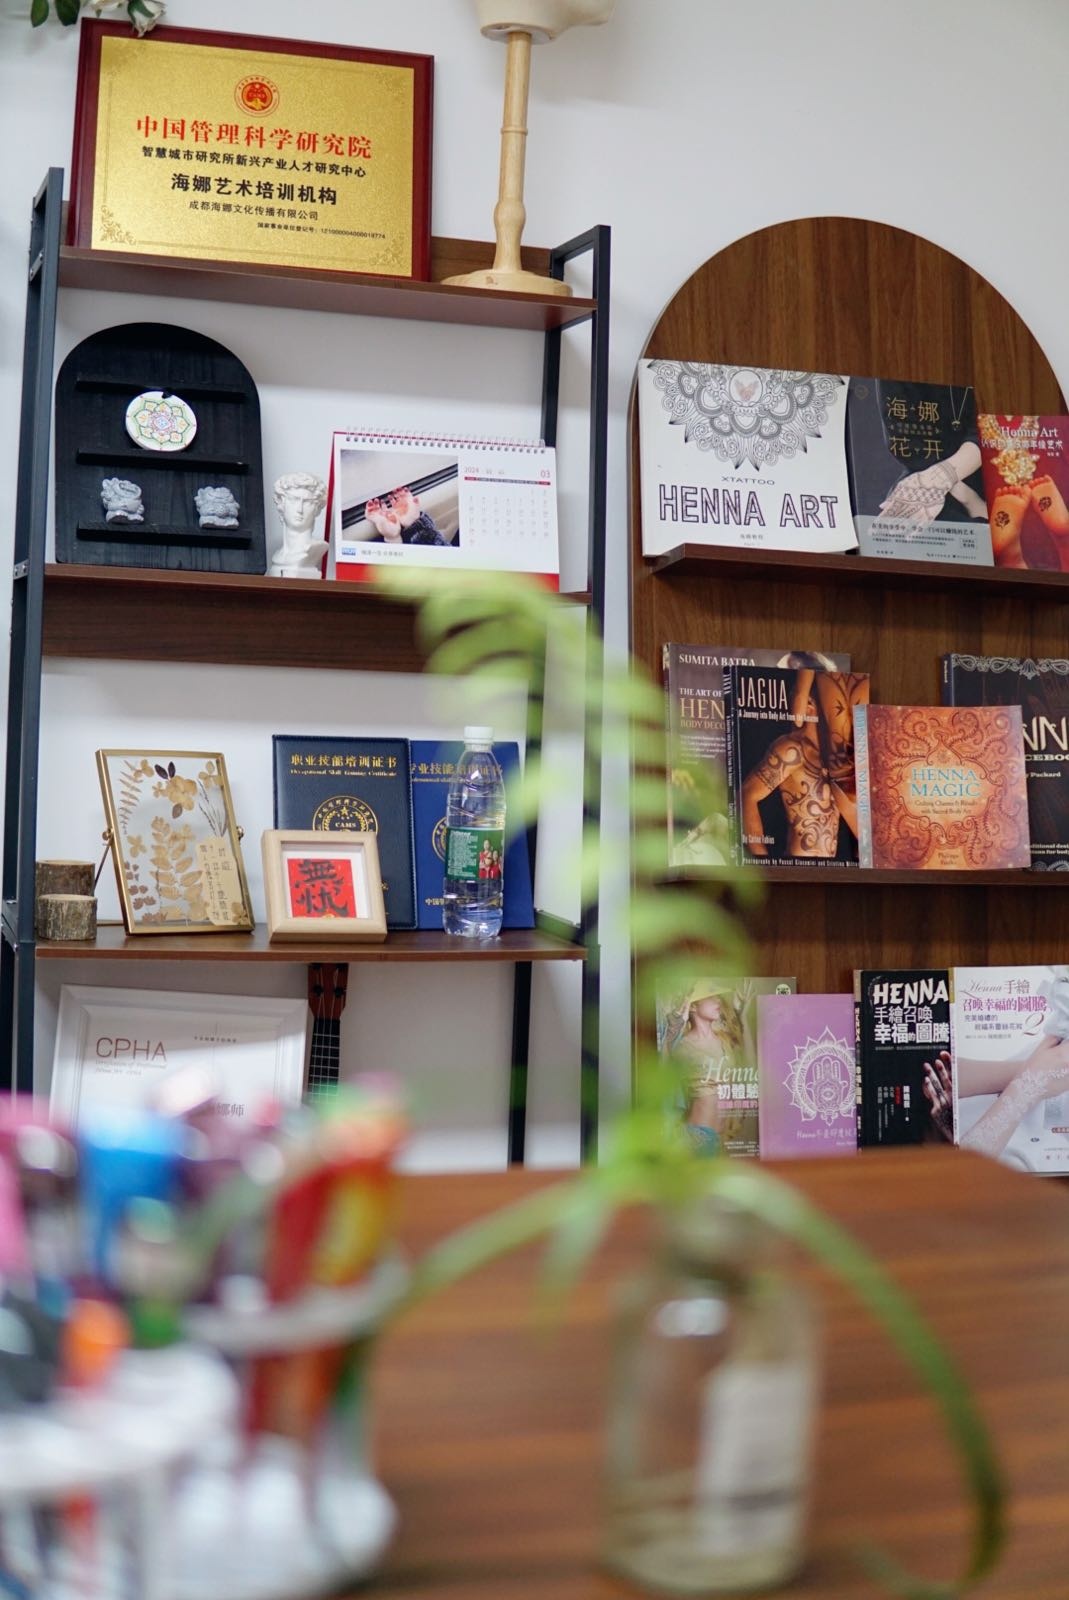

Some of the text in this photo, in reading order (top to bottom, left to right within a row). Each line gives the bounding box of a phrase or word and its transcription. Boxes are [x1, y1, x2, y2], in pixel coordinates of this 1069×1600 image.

[136, 115, 373, 160] 中国管理科学研究院
[142, 145, 367, 178] 智慧城市研究所新兴产业人才研究中心
[171, 173, 338, 206] 海娜艺术培训机构
[189, 200, 319, 221] 成都海娜文化传播有限公司
[886, 396, 940, 423] 海娜
[1001, 426, 1058, 438] Henna Art
[889, 436, 944, 460] 花开
[721, 476, 776, 486] XTATTOO
[659, 484, 838, 528] HENNA ART
[679, 654, 755, 667] SUMITA BATRA
[680, 687, 695, 696] THE
[695, 688, 711, 697] ART
[738, 677, 788, 711] JAGUA
[680, 720, 702, 729] BODY
[743, 710, 759, 720] Journey
[769, 711, 778, 721] Body
[291, 754, 397, 768] 职业技能培训证书
[912, 769, 978, 780] HENNA
[911, 784, 980, 797] MAGIC
[873, 978, 949, 1008] HENNA
[1003, 979, 1030, 994] 手繪
[963, 996, 1047, 1012] 召喚幸福的圖騰
[874, 1006, 933, 1024] 手繪召喚
[1023, 1012, 1045, 1036] 2
[874, 1023, 950, 1044] 幸福的圖騰
[96, 1037, 167, 1061] CPHA
